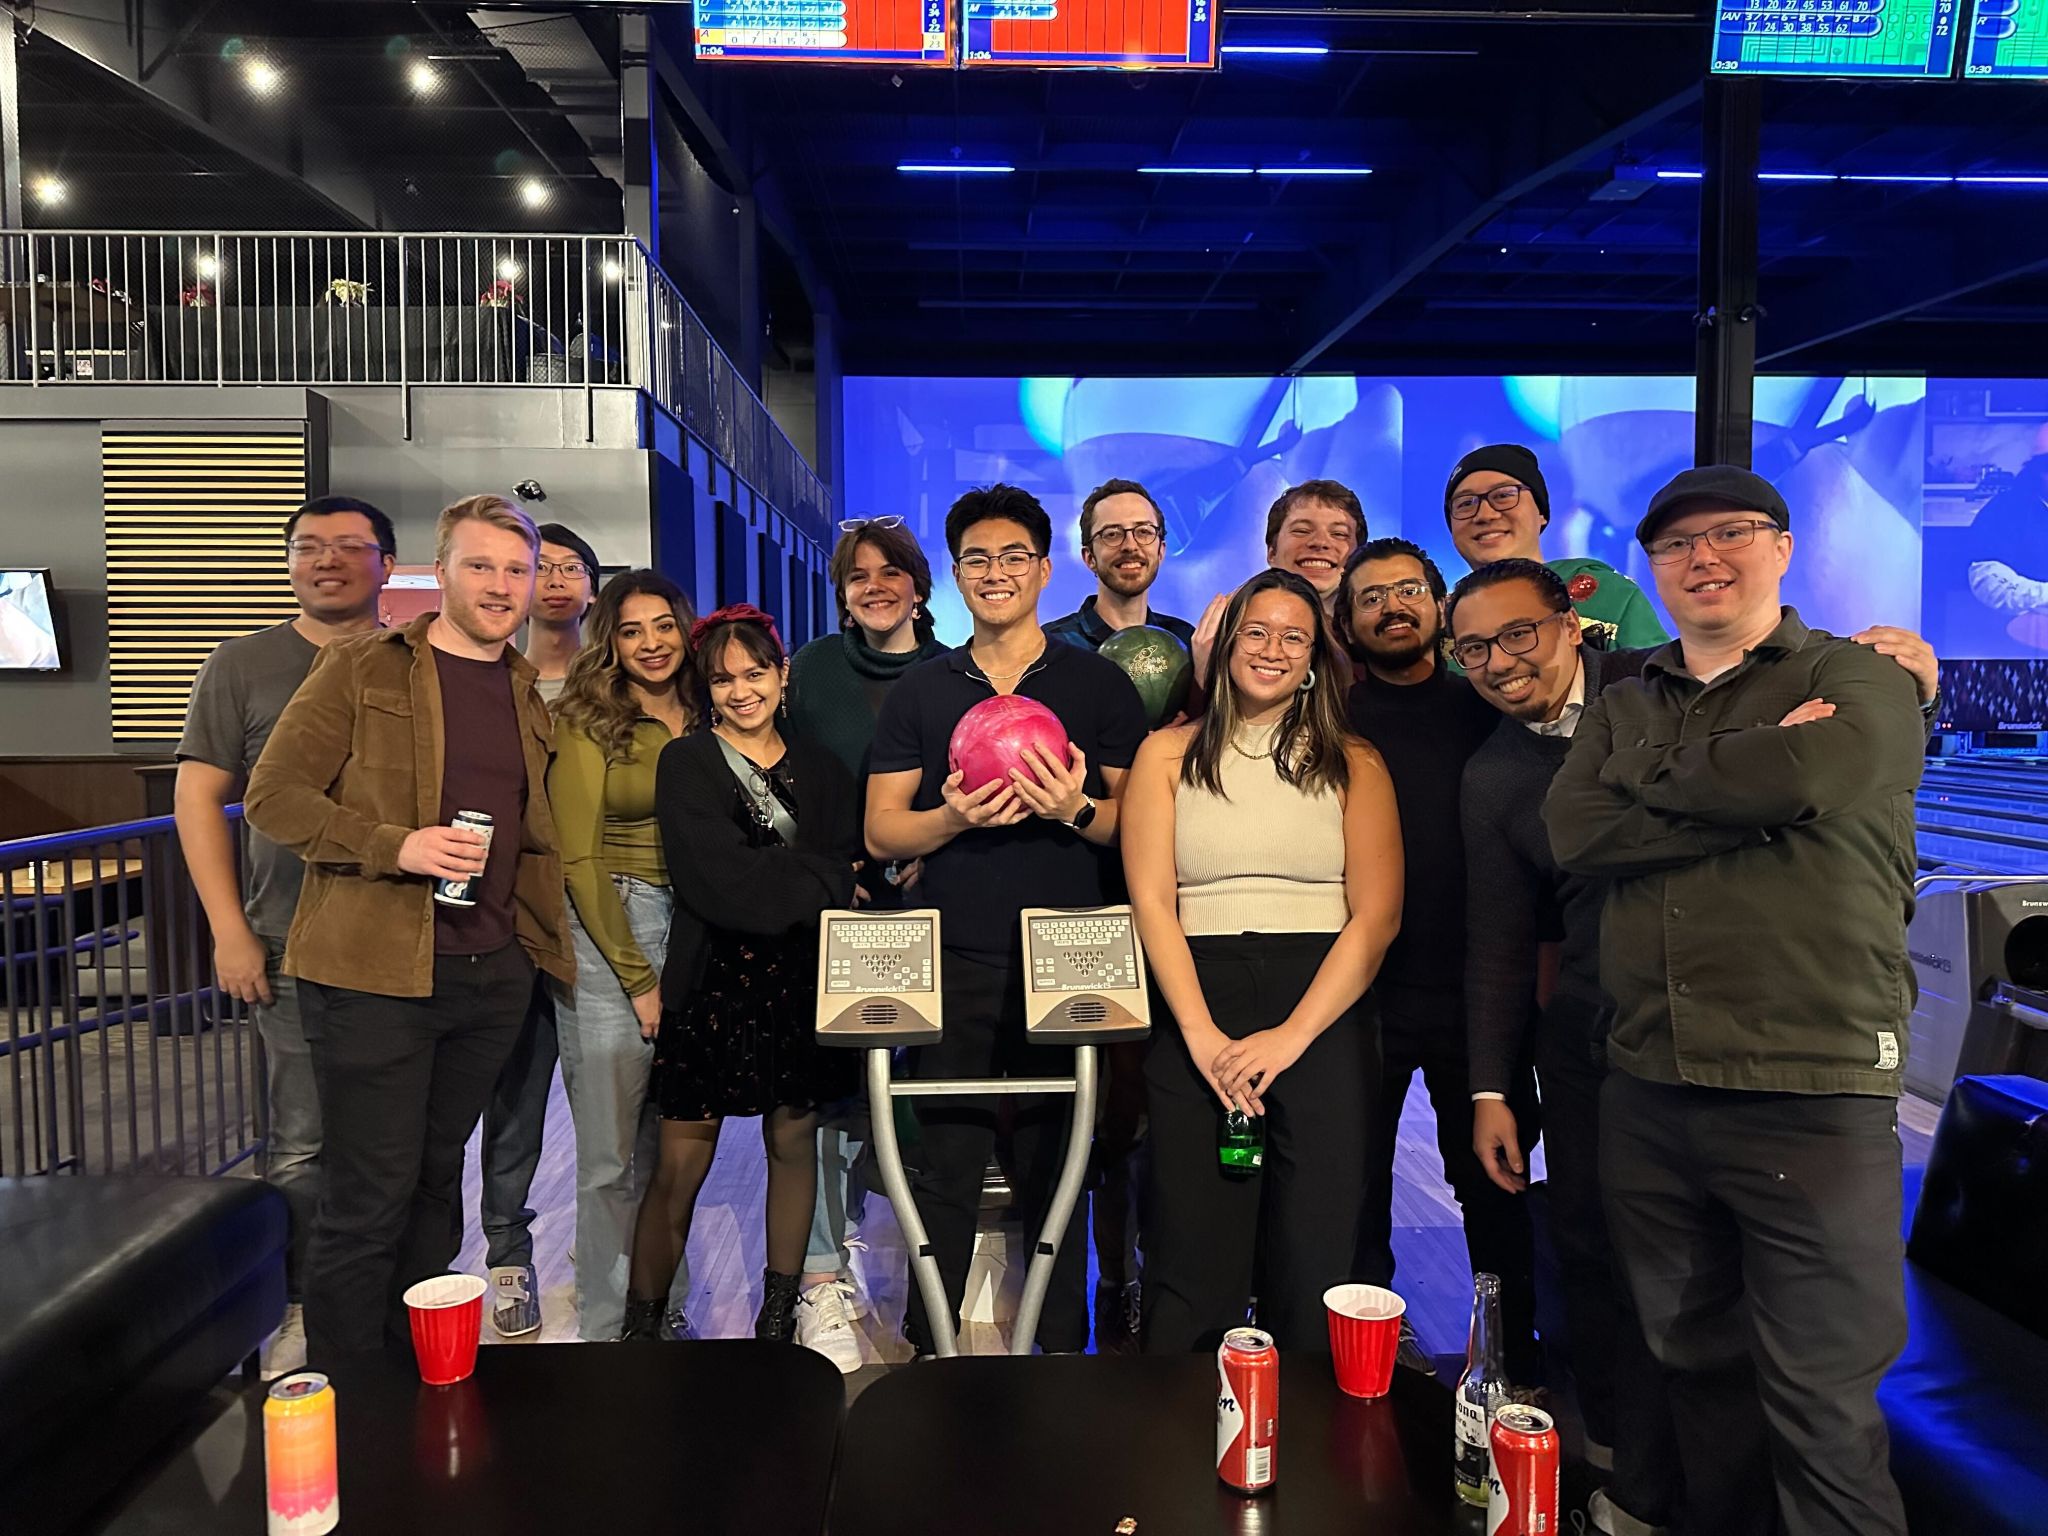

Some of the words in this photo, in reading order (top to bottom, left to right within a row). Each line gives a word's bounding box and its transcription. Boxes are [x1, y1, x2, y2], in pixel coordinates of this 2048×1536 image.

[1751, 0, 1759, 9] 13
[1767, 0, 1779, 9] 20
[1785, 0, 1796, 10] 27
[1803, 1, 1814, 10] 45
[1821, 1, 1832, 10] 53
[1840, 1, 1849, 11] 61
[1857, 1, 1868, 11] 70
[1939, 3, 1951, 13] 70
[1721, 12, 1740, 20] IAN
[928, 24, 940, 32] 22
[1748, 22, 1757, 32] 17
[1764, 23, 1776, 32] 24
[1783, 23, 1794, 32] 30
[1800, 23, 1812, 32] 38
[1818, 24, 1830, 33] 55
[1836, 24, 1848, 33] 62
[1936, 26, 1948, 35] 72
[701, 29, 709, 37] A
[702, 46, 724, 55] 1:06
[969, 51, 991, 60] 1:06
[1714, 61, 1738, 70] 0:30
[1968, 65, 1992, 74] 0:30
